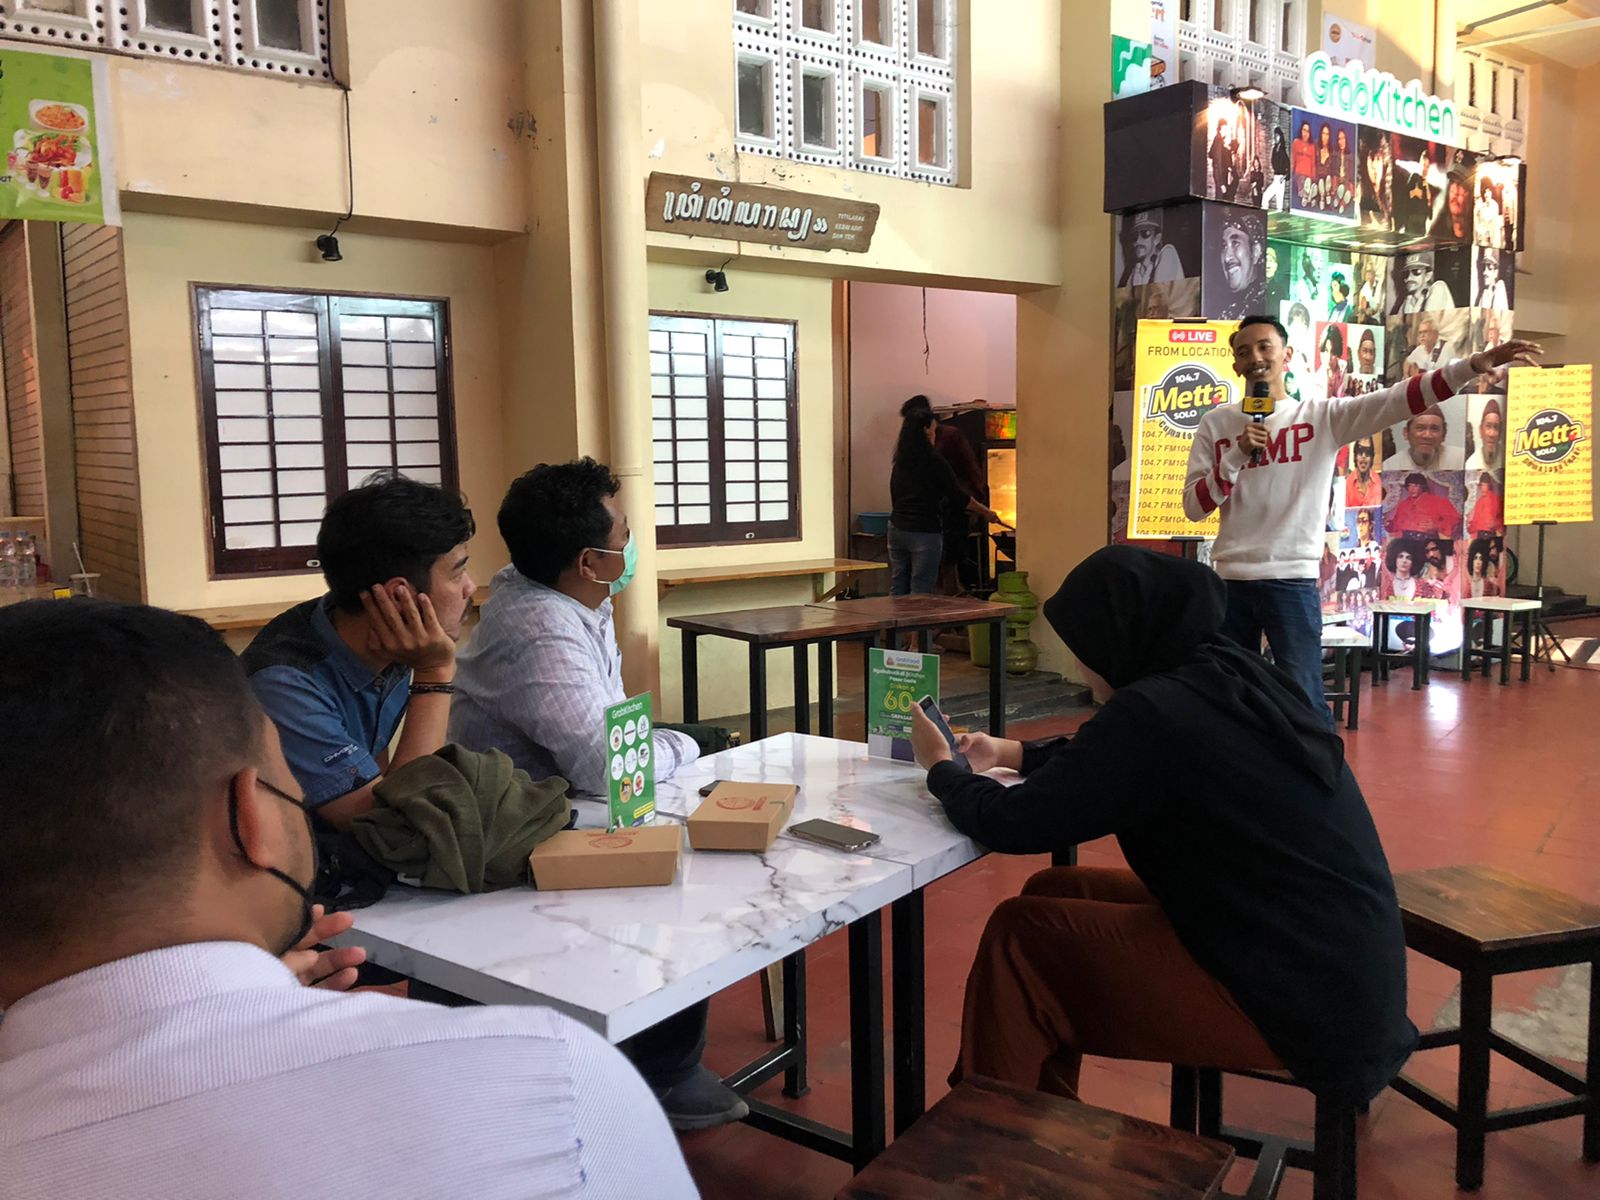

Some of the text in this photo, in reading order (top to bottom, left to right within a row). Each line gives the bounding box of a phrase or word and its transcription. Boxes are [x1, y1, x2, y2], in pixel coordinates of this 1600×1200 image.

[1310, 58, 1454, 137] GrabKitchen
[1188, 332, 1213, 341] LIVE
[1148, 346, 1180, 356] FROM
[1175, 372, 1200, 383] 104.7
[1151, 384, 1229, 414] Metta
[1173, 410, 1198, 420] SOLO
[1518, 423, 1582, 452] Metta
[1535, 446, 1557, 456] SOLO
[883, 690, 913, 713] 60
